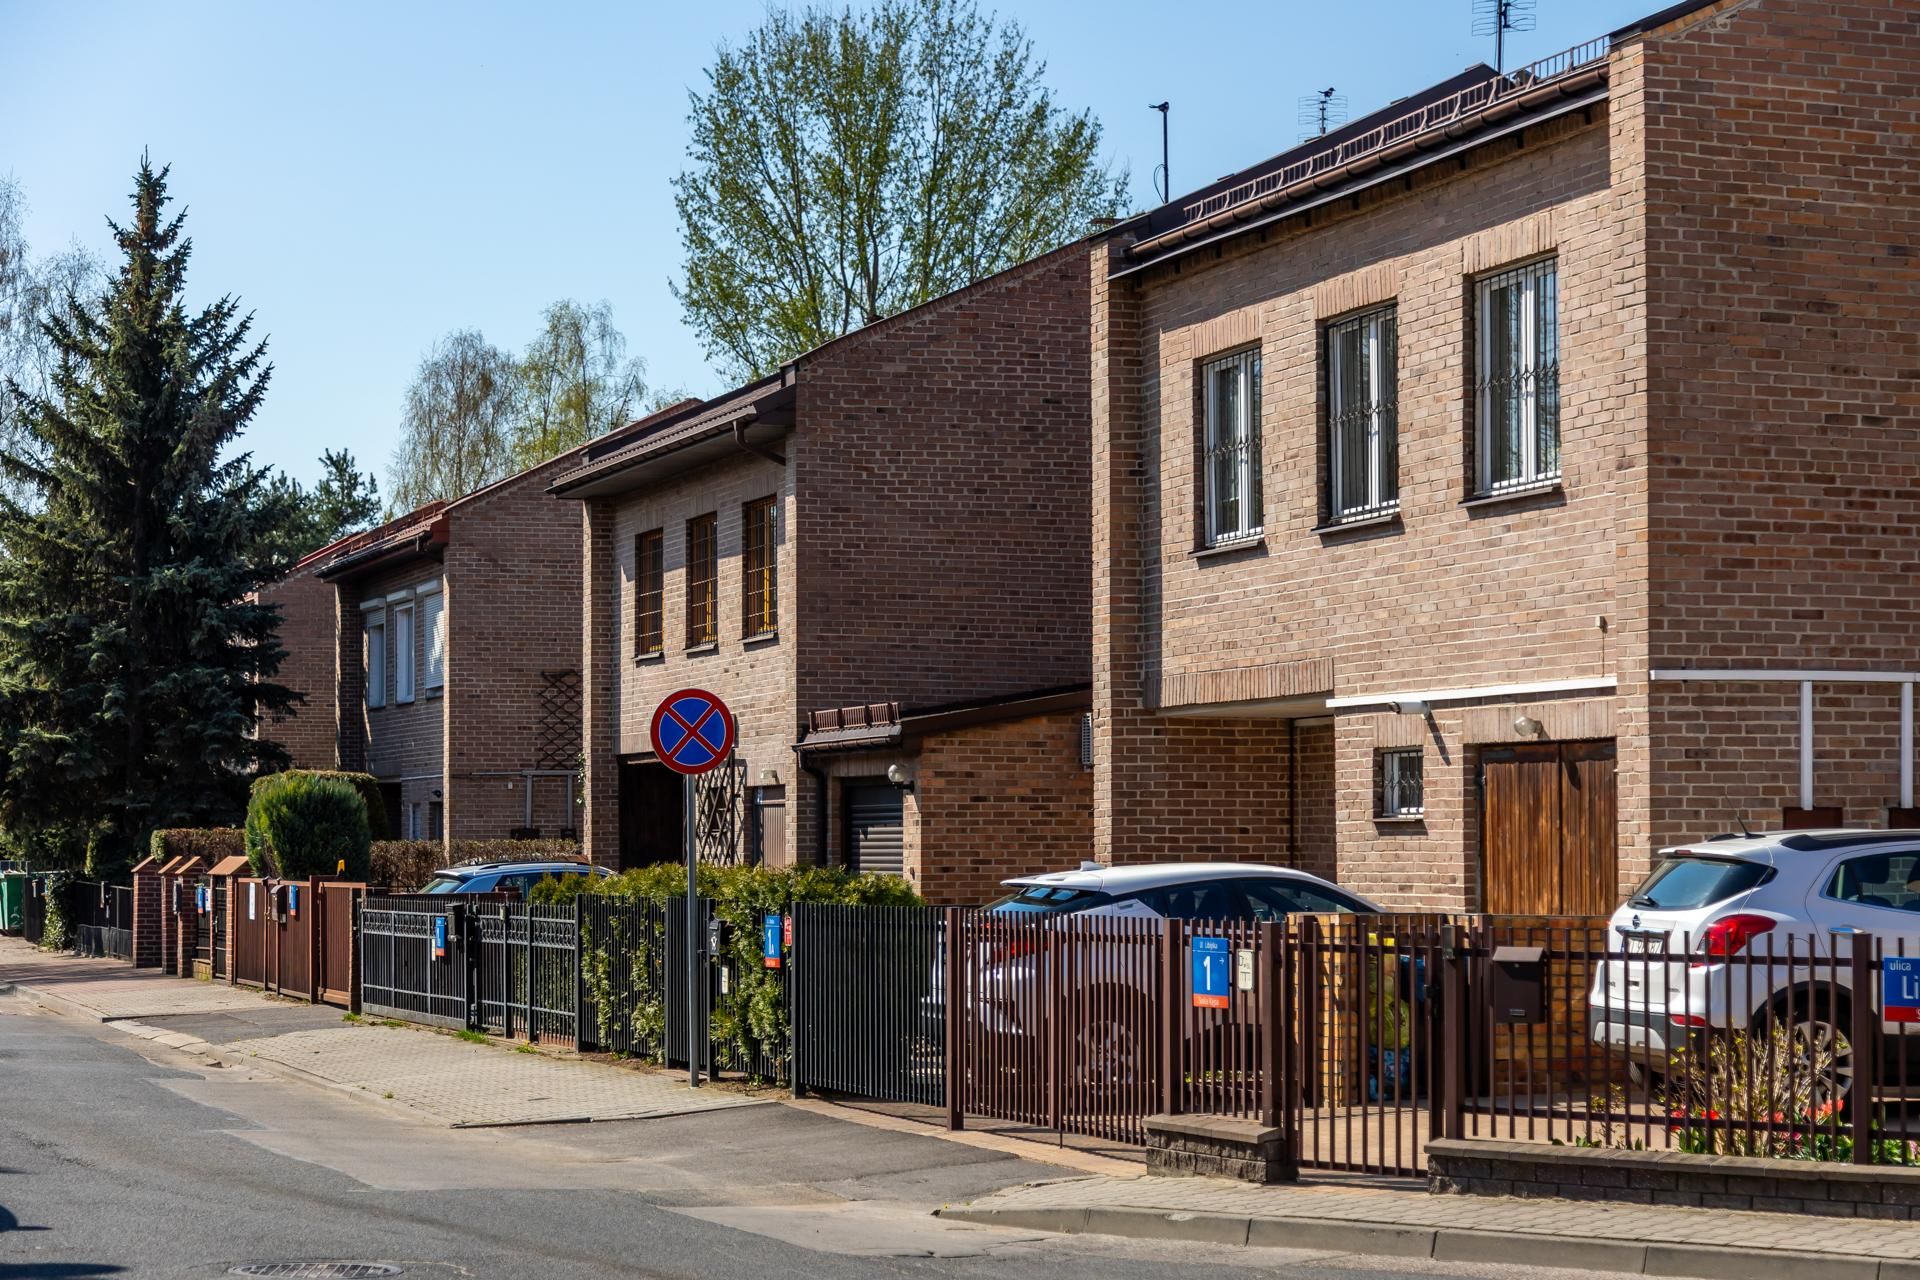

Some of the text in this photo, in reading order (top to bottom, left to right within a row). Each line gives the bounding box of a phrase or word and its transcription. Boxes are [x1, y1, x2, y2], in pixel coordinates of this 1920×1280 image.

[1203, 955, 1211, 991] 1
[1889, 960, 1911, 971] ulica
[1902, 975, 1919, 1000] Li
